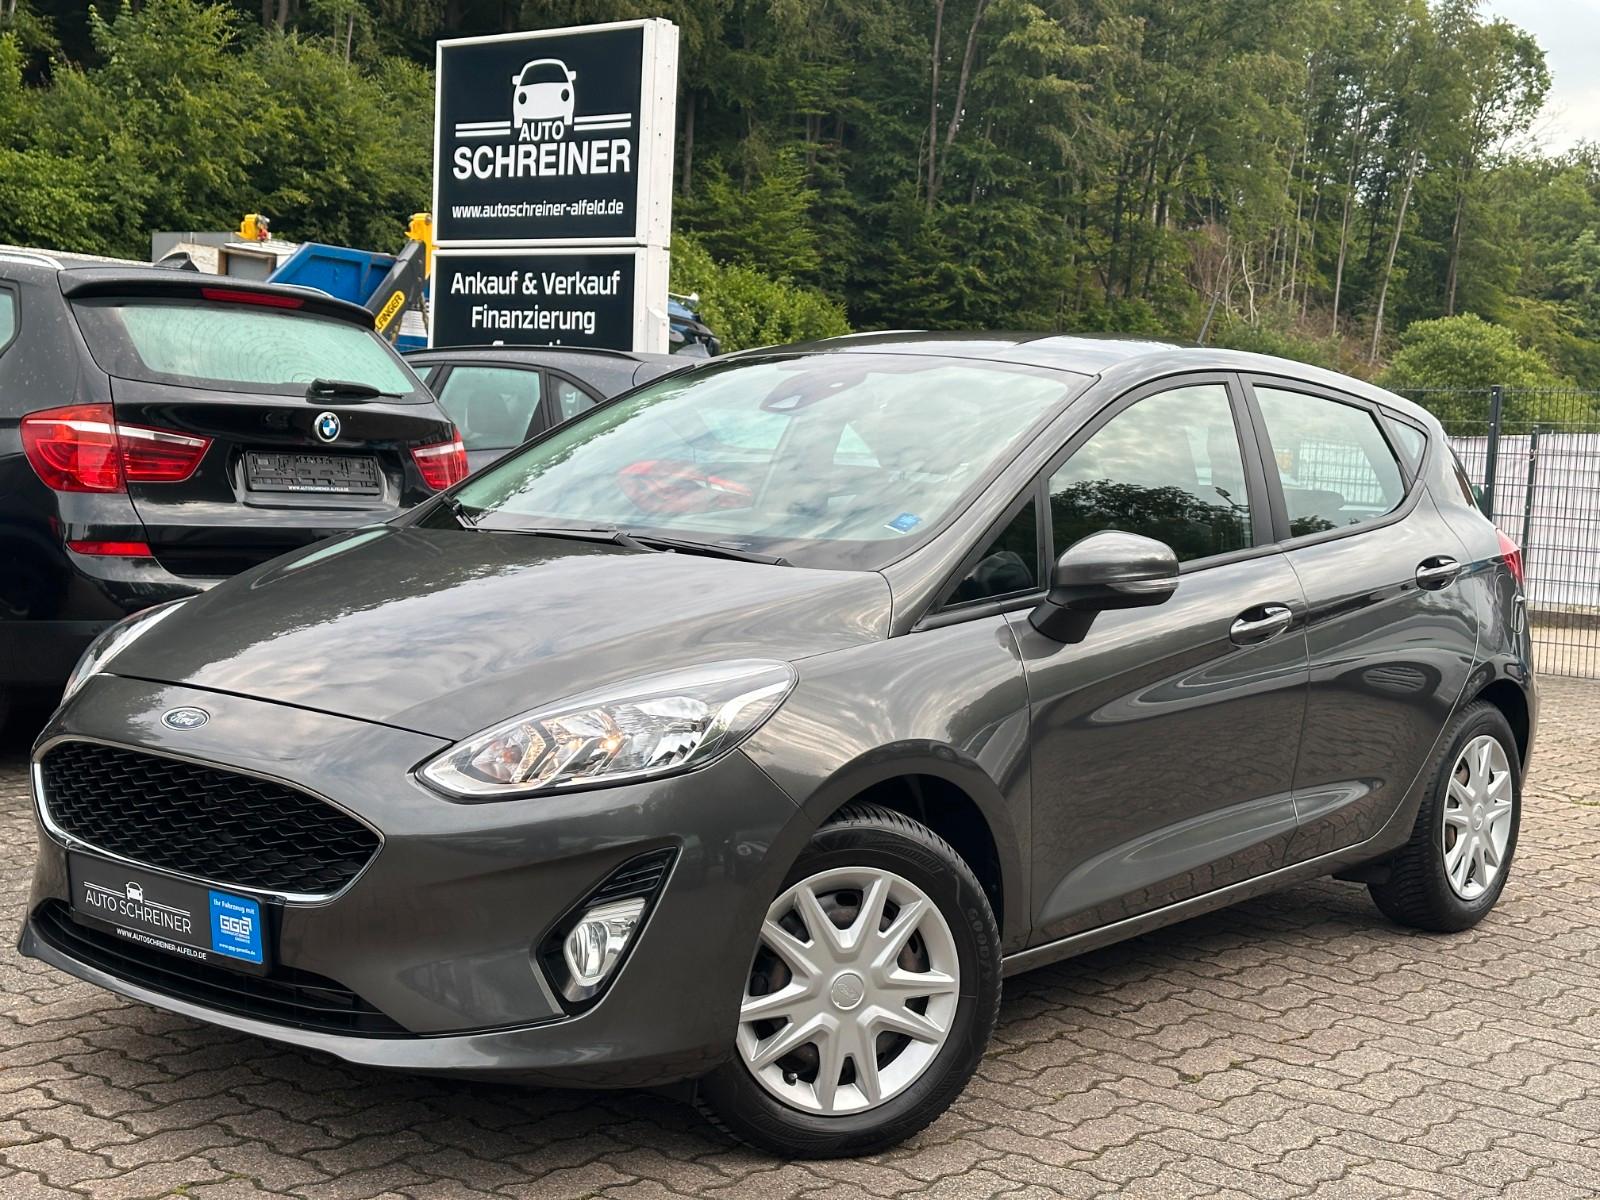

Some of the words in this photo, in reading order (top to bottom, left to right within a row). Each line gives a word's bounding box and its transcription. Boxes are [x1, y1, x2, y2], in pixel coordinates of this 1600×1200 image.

[518, 119, 565, 142] AUTO
[452, 138, 632, 180] SCHREINER
[451, 199, 624, 219] www.autoschreiner-alfeld.de
[450, 270, 519, 296] Ankauf
[521, 272, 538, 296] &
[541, 270, 621, 296] Verkauf
[471, 304, 596, 335] Finanzierung
[85, 889, 117, 912] AUTO
[119, 900, 192, 934] SCHREINER
[219, 914, 251, 935] GGG
[116, 927, 207, 960] WWW.AUTOSCHREINER-ALFELD.DE
